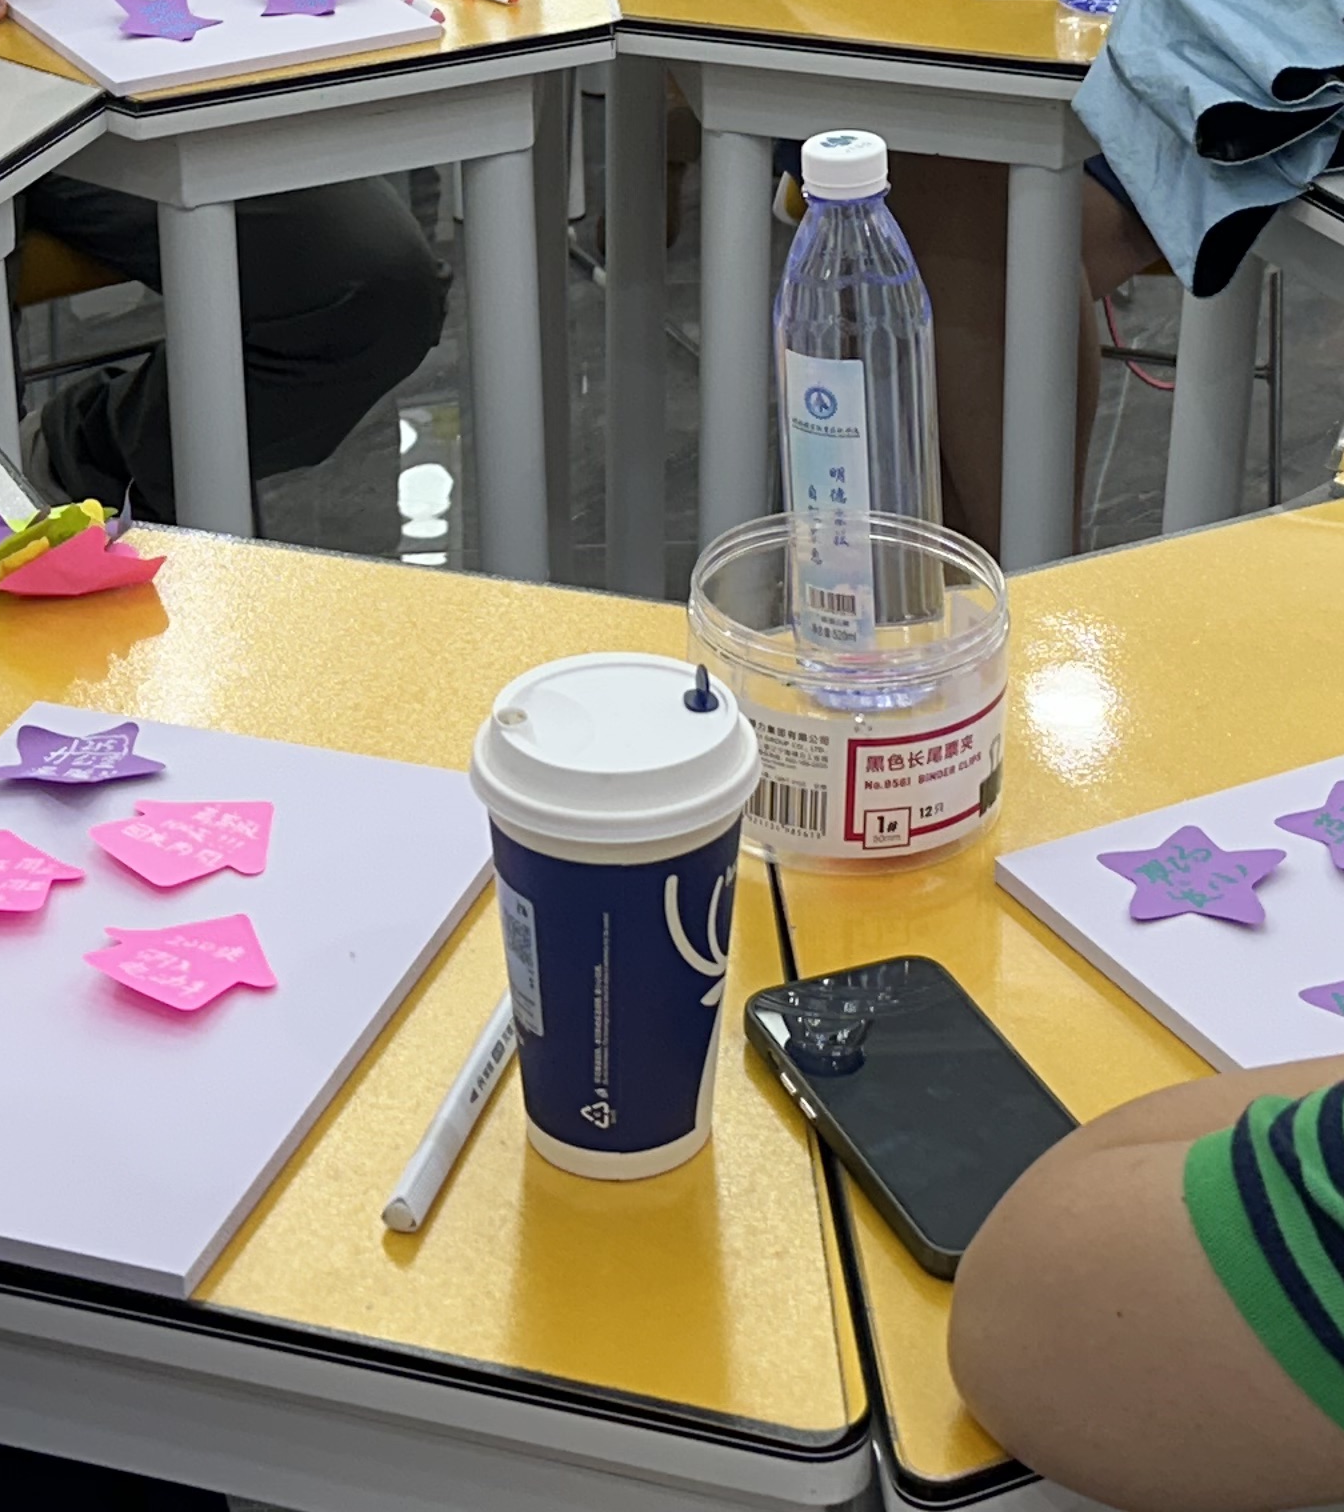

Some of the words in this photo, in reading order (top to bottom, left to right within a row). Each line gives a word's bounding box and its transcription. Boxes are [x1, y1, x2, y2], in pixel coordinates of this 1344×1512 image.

[865, 734, 974, 773] 黑色长尾票夹
[958, 752, 982, 771] CLIPS
